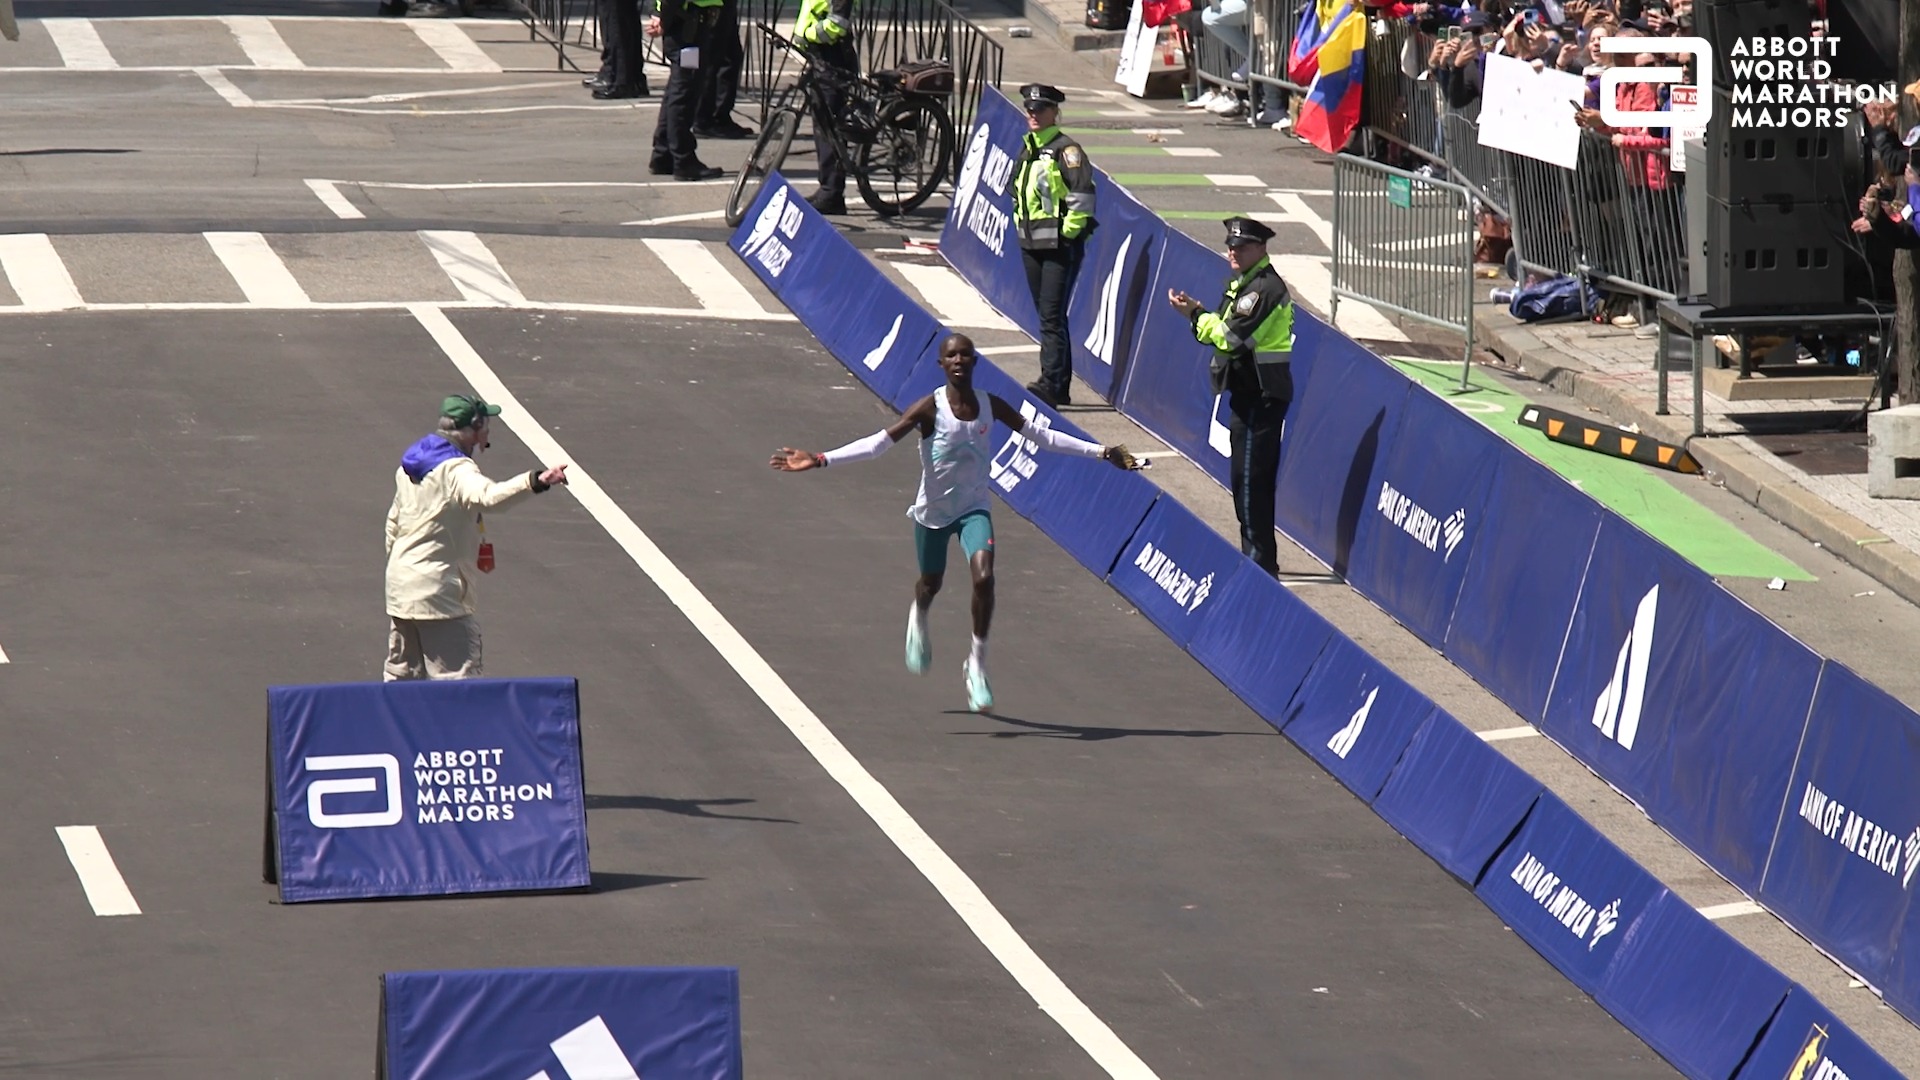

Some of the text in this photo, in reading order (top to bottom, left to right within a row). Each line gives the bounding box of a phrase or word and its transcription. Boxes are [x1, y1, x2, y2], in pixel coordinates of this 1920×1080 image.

[967, 192, 1009, 256] ATHLETICS
[1393, 494, 1411, 527] OF
[1403, 502, 1441, 552] AMERICA
[413, 748, 503, 768] ABBOTT
[414, 768, 498, 786] WORLD
[416, 782, 553, 806] MARATHON
[418, 804, 515, 824] MAJORS
[1823, 800, 1845, 840] OF
[1840, 810, 1902, 877] AMERICA
[1533, 872, 1560, 905] OF
